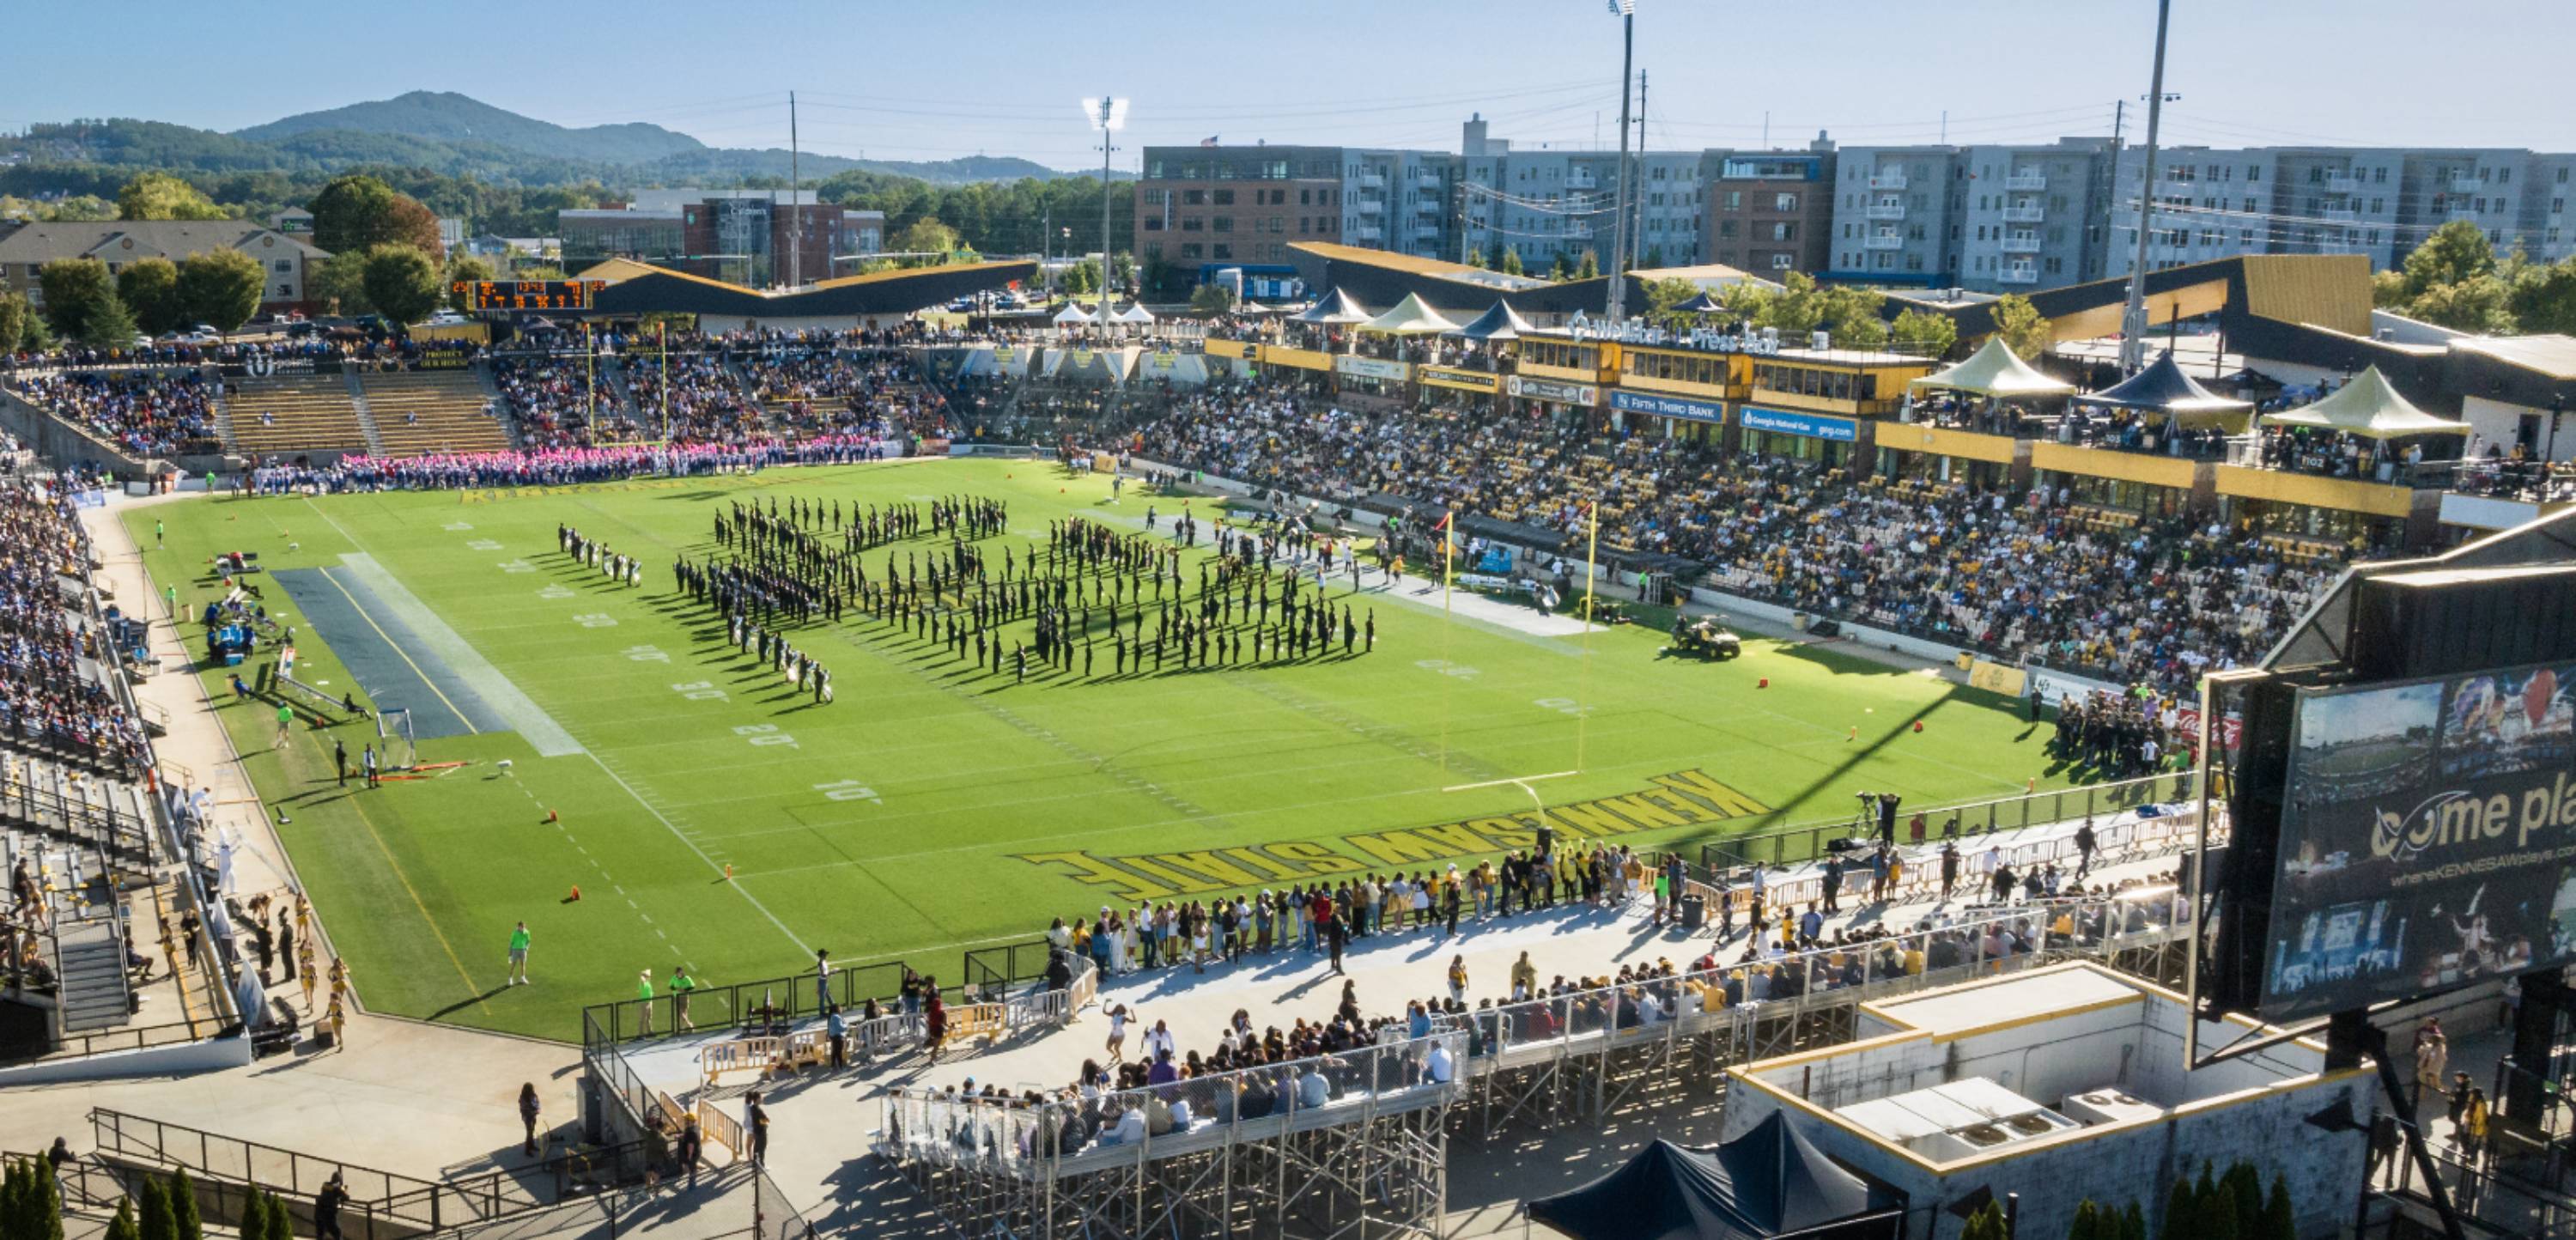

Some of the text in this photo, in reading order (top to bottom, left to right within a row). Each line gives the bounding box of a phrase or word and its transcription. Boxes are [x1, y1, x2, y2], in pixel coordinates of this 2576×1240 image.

[1691, 328, 1738, 351] Press
[1632, 398, 1715, 418] FIFTH THIRD BANK
[731, 723, 795, 746] 20
[811, 778, 878, 801] 10
[1006, 769, 1775, 902] KENNESAW STATE
